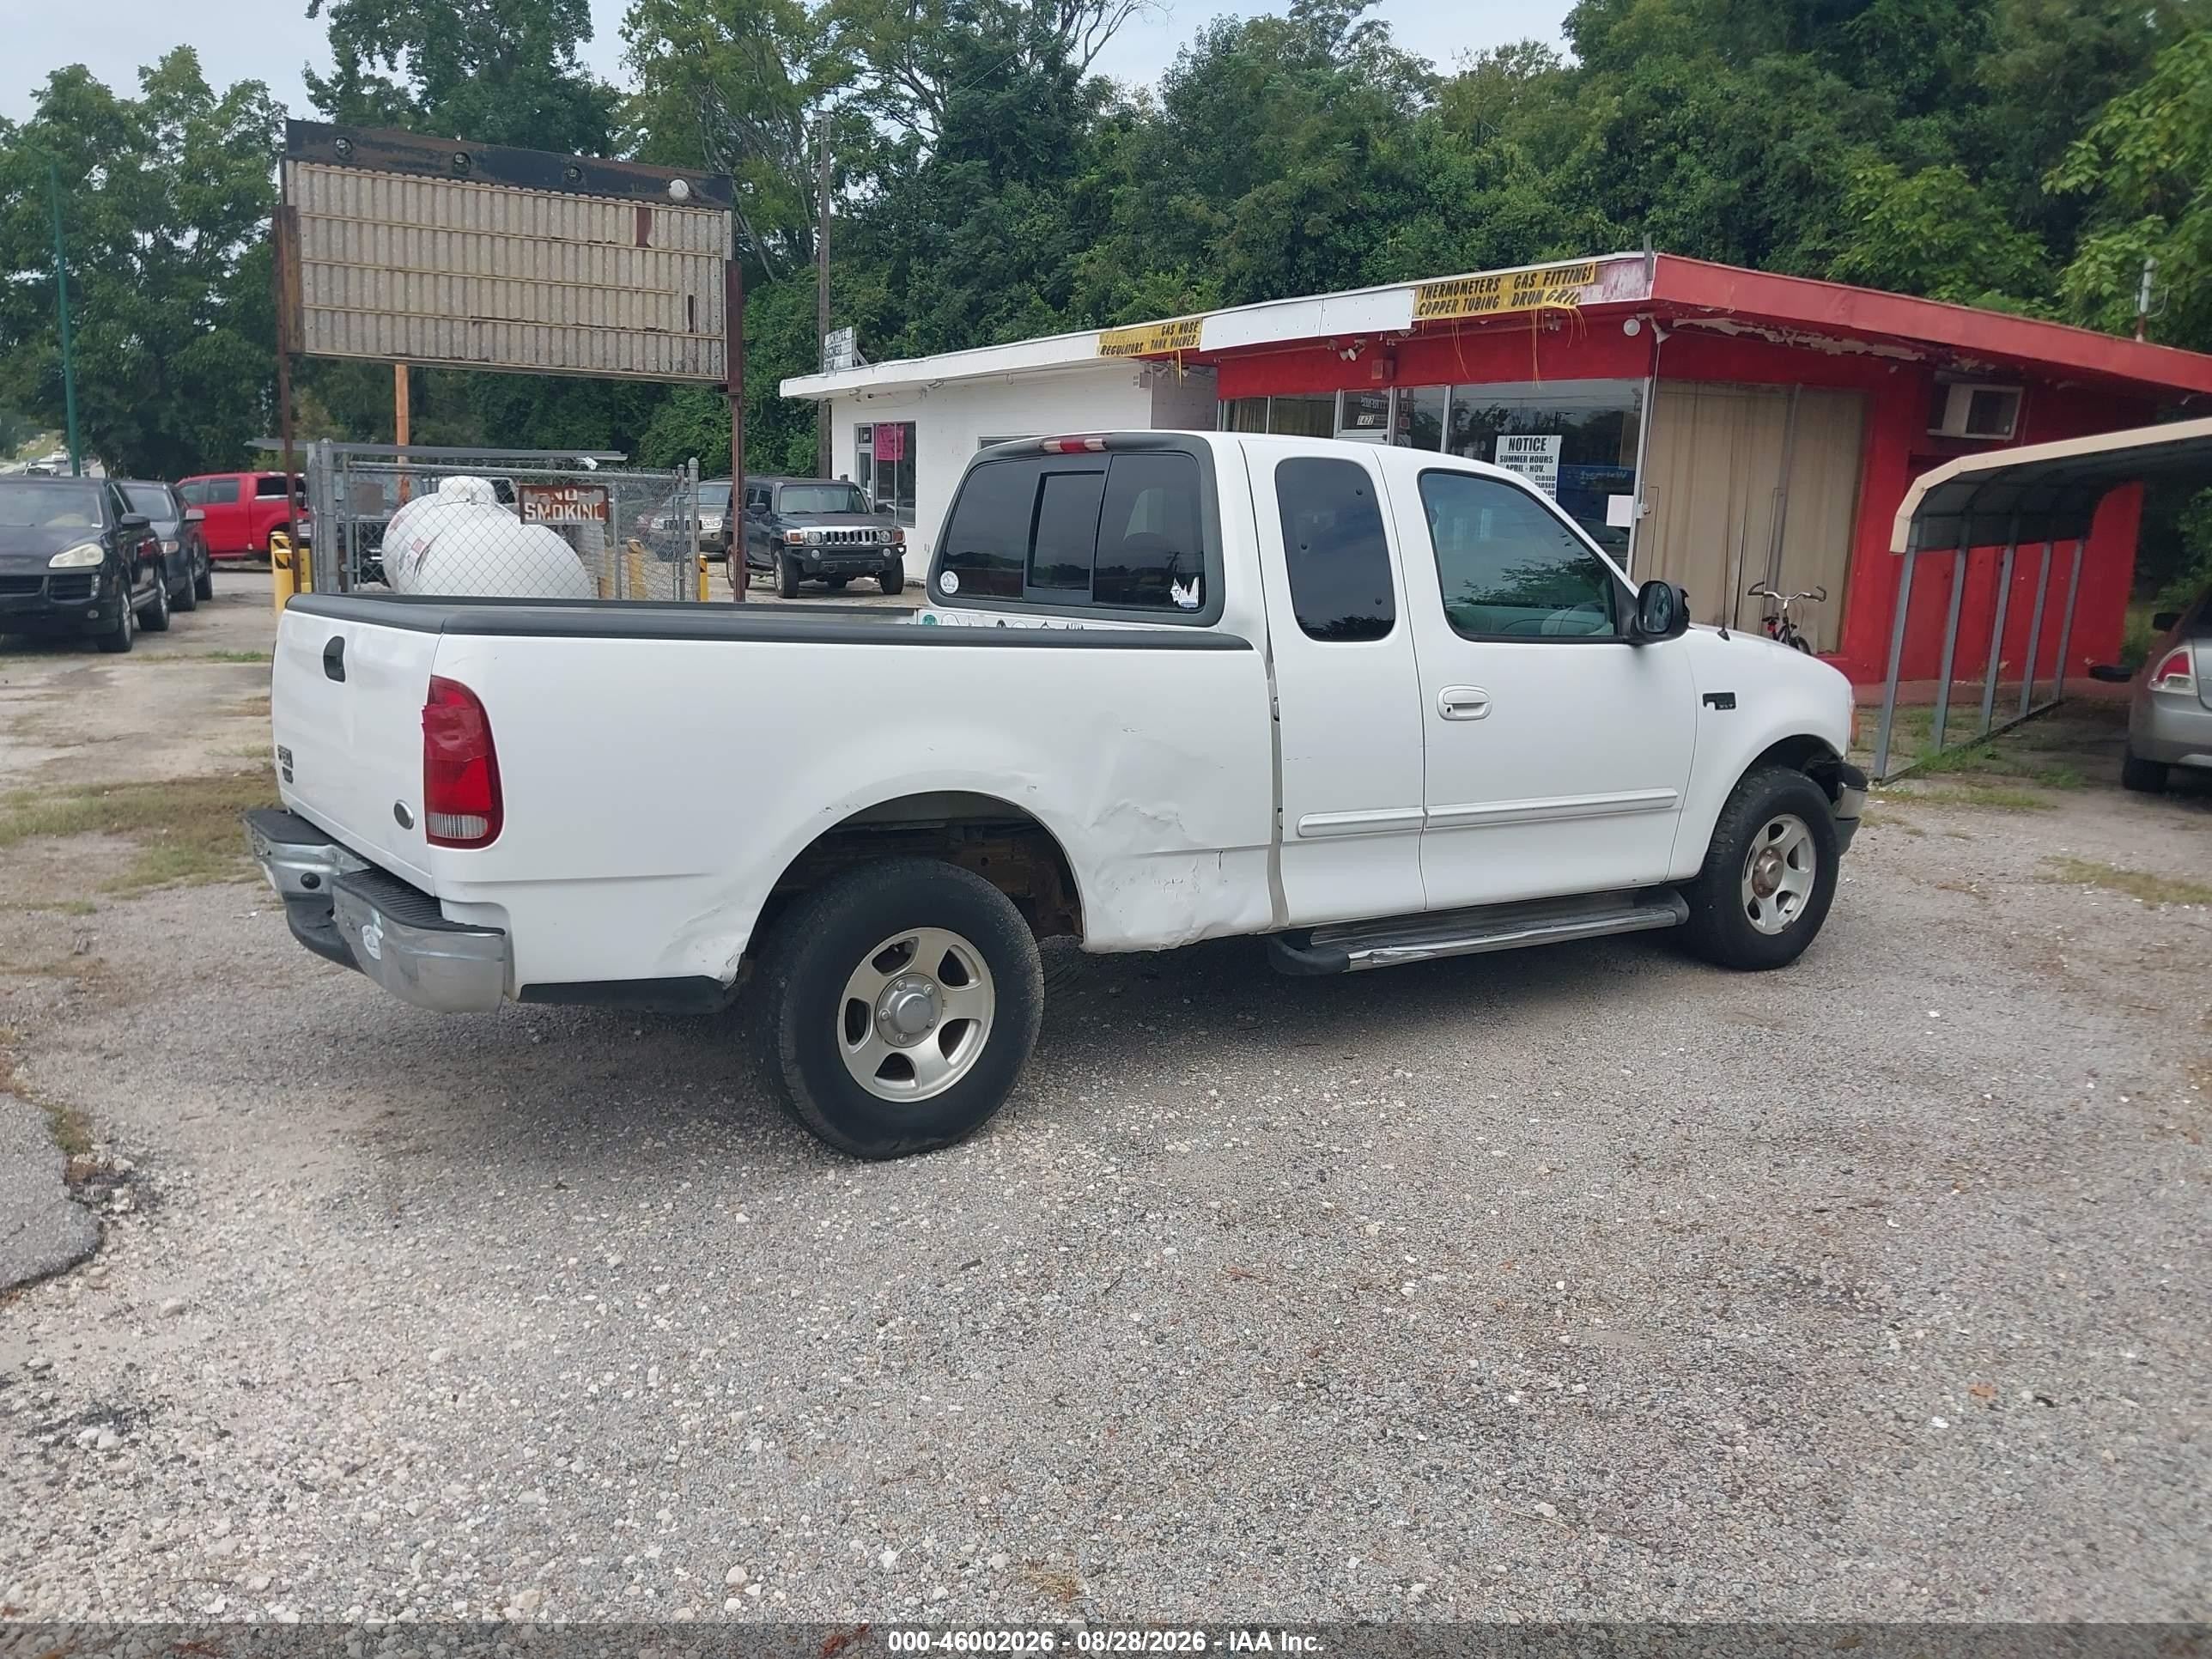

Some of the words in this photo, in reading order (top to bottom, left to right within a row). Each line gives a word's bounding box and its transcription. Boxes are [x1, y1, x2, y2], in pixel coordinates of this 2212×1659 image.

[1421, 277, 1501, 300] THERMOMETERS
[1514, 273, 1538, 289] GAS
[1542, 266, 1594, 286] FITTINGS
[1419, 298, 1459, 316] COPPER
[1462, 295, 1500, 312] TUBING
[1511, 289, 1545, 307] DRUM
[1161, 324, 1175, 337] GAS
[1178, 321, 1200, 333] HOSE
[1100, 342, 1144, 356] REGULATORS
[1151, 338, 1167, 350] TANK
[1170, 335, 1196, 347] VALVES
[1508, 437, 1547, 452] NOTICE
[1499, 454, 1528, 463] SUMMER
[1528, 455, 1553, 464] HOURS
